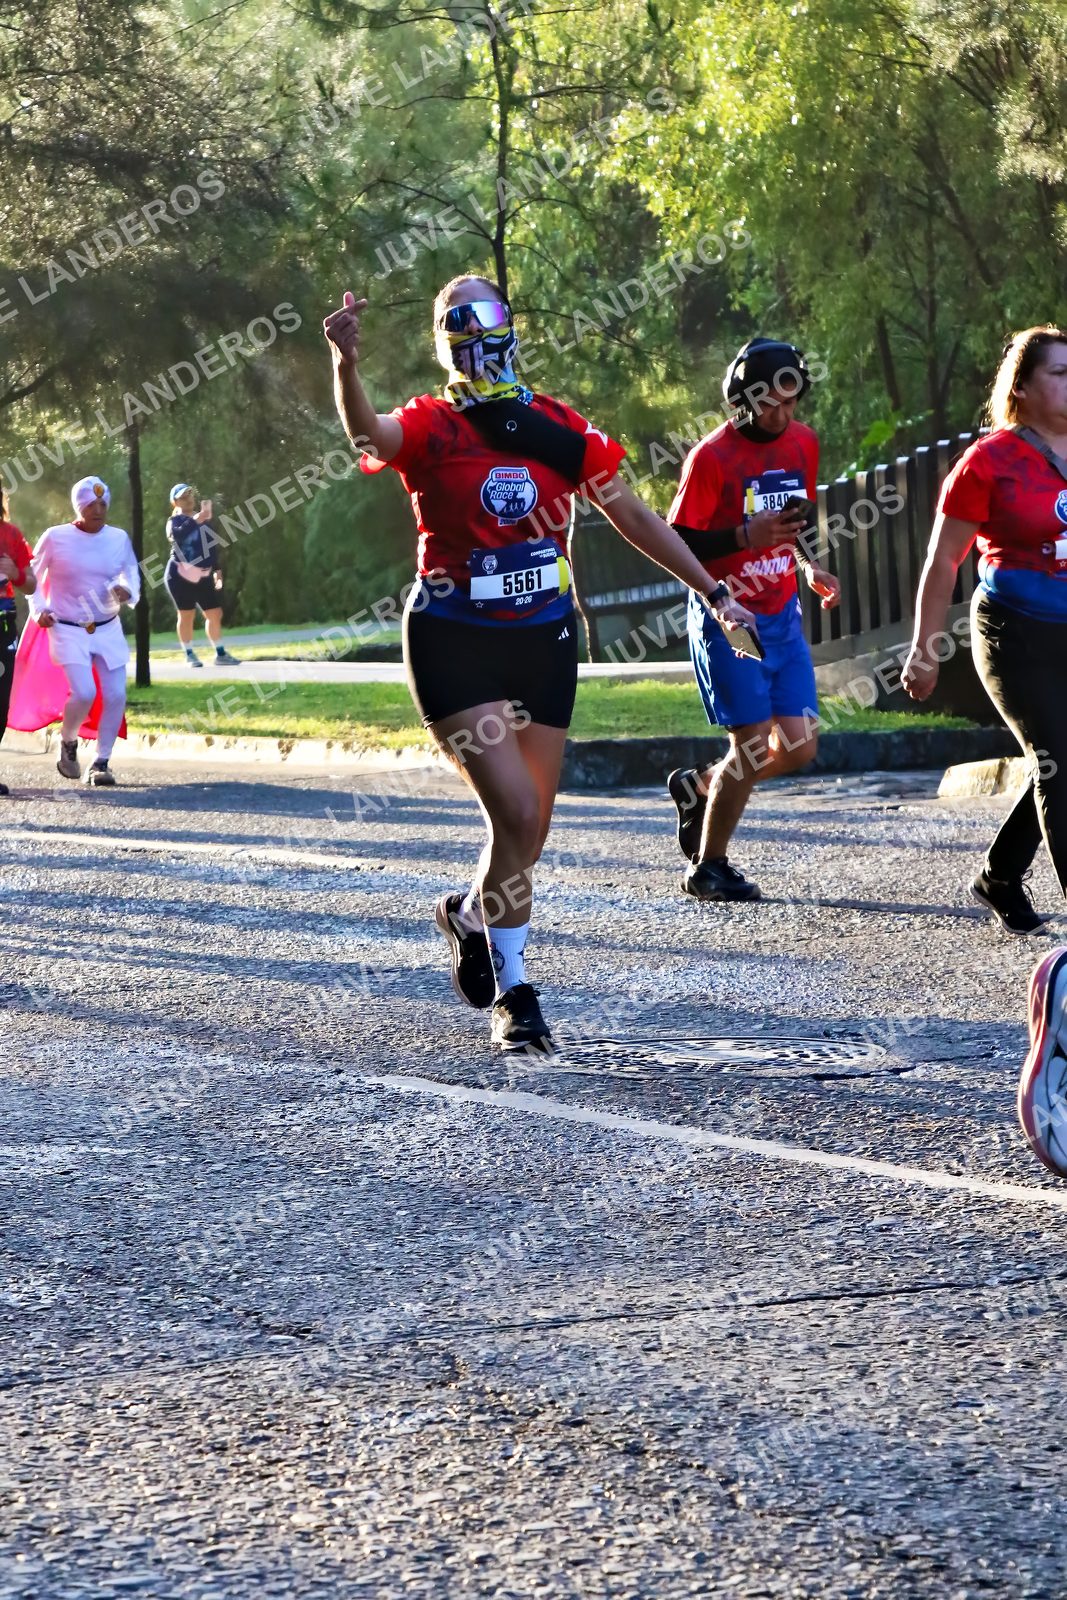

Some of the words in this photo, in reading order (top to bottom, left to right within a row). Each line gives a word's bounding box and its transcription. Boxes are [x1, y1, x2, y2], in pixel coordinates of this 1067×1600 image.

[496, 482, 524, 491] Global
[490, 490, 513, 499] Race
[503, 568, 542, 595] 5561
